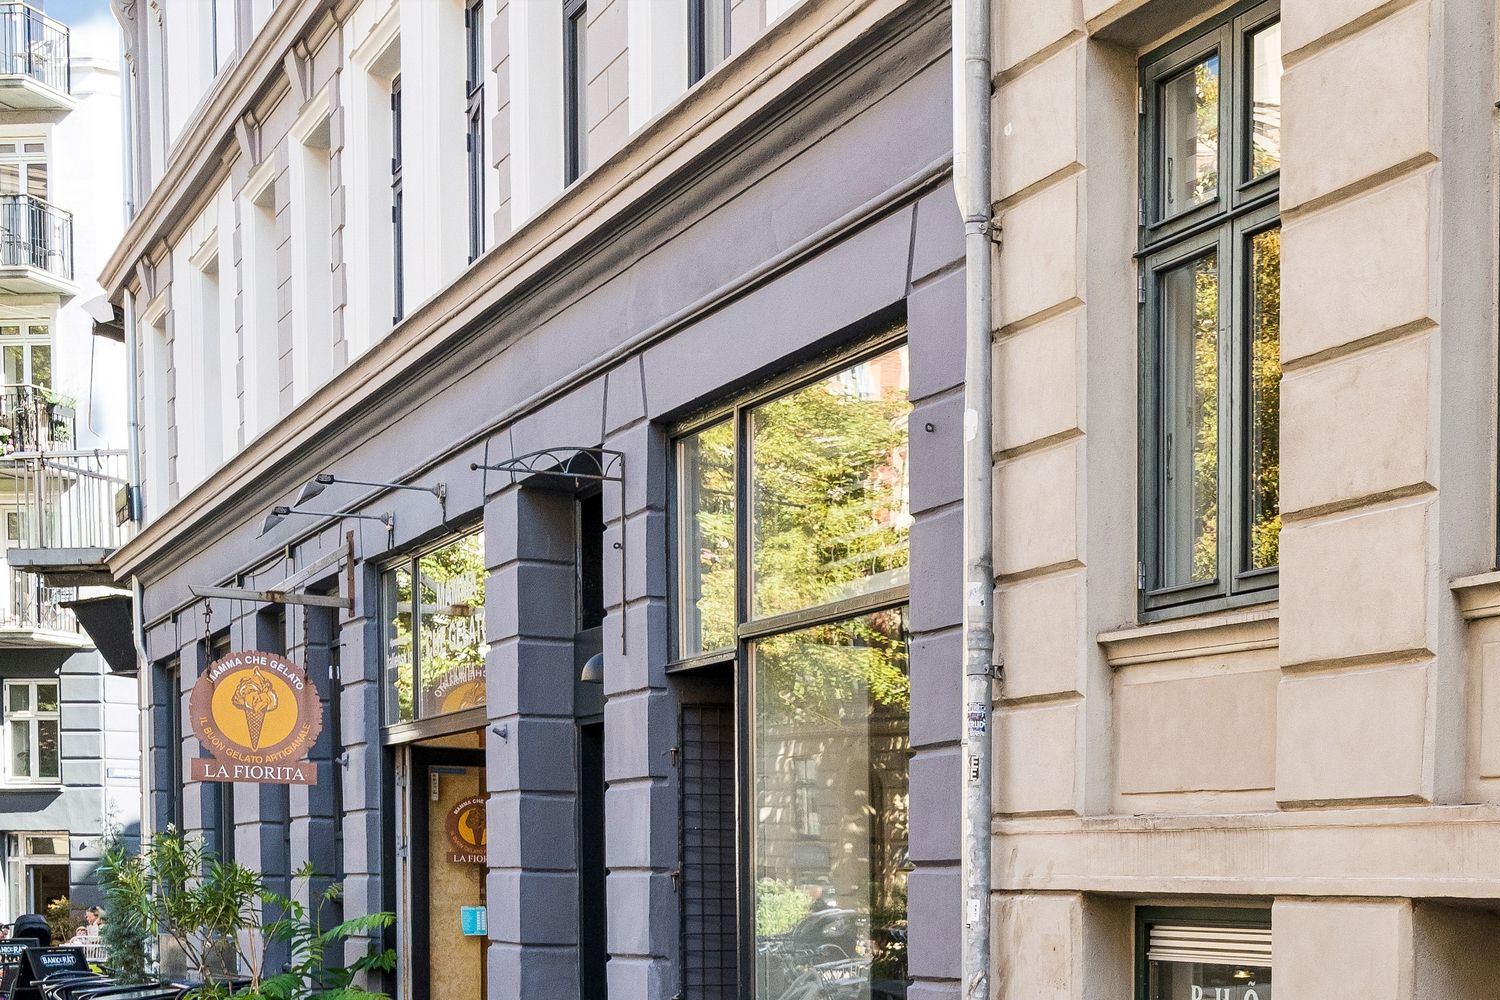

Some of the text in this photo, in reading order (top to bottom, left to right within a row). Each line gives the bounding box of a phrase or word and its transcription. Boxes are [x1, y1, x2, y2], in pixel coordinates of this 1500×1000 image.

[245, 656, 267, 666] CHE
[270, 660, 304, 690] GELATO
[203, 727, 225, 751] BUON
[226, 748, 263, 764] GELATO
[266, 724, 311, 763] ARTIGIANALE
[204, 764, 305, 781] LA FIORITA
